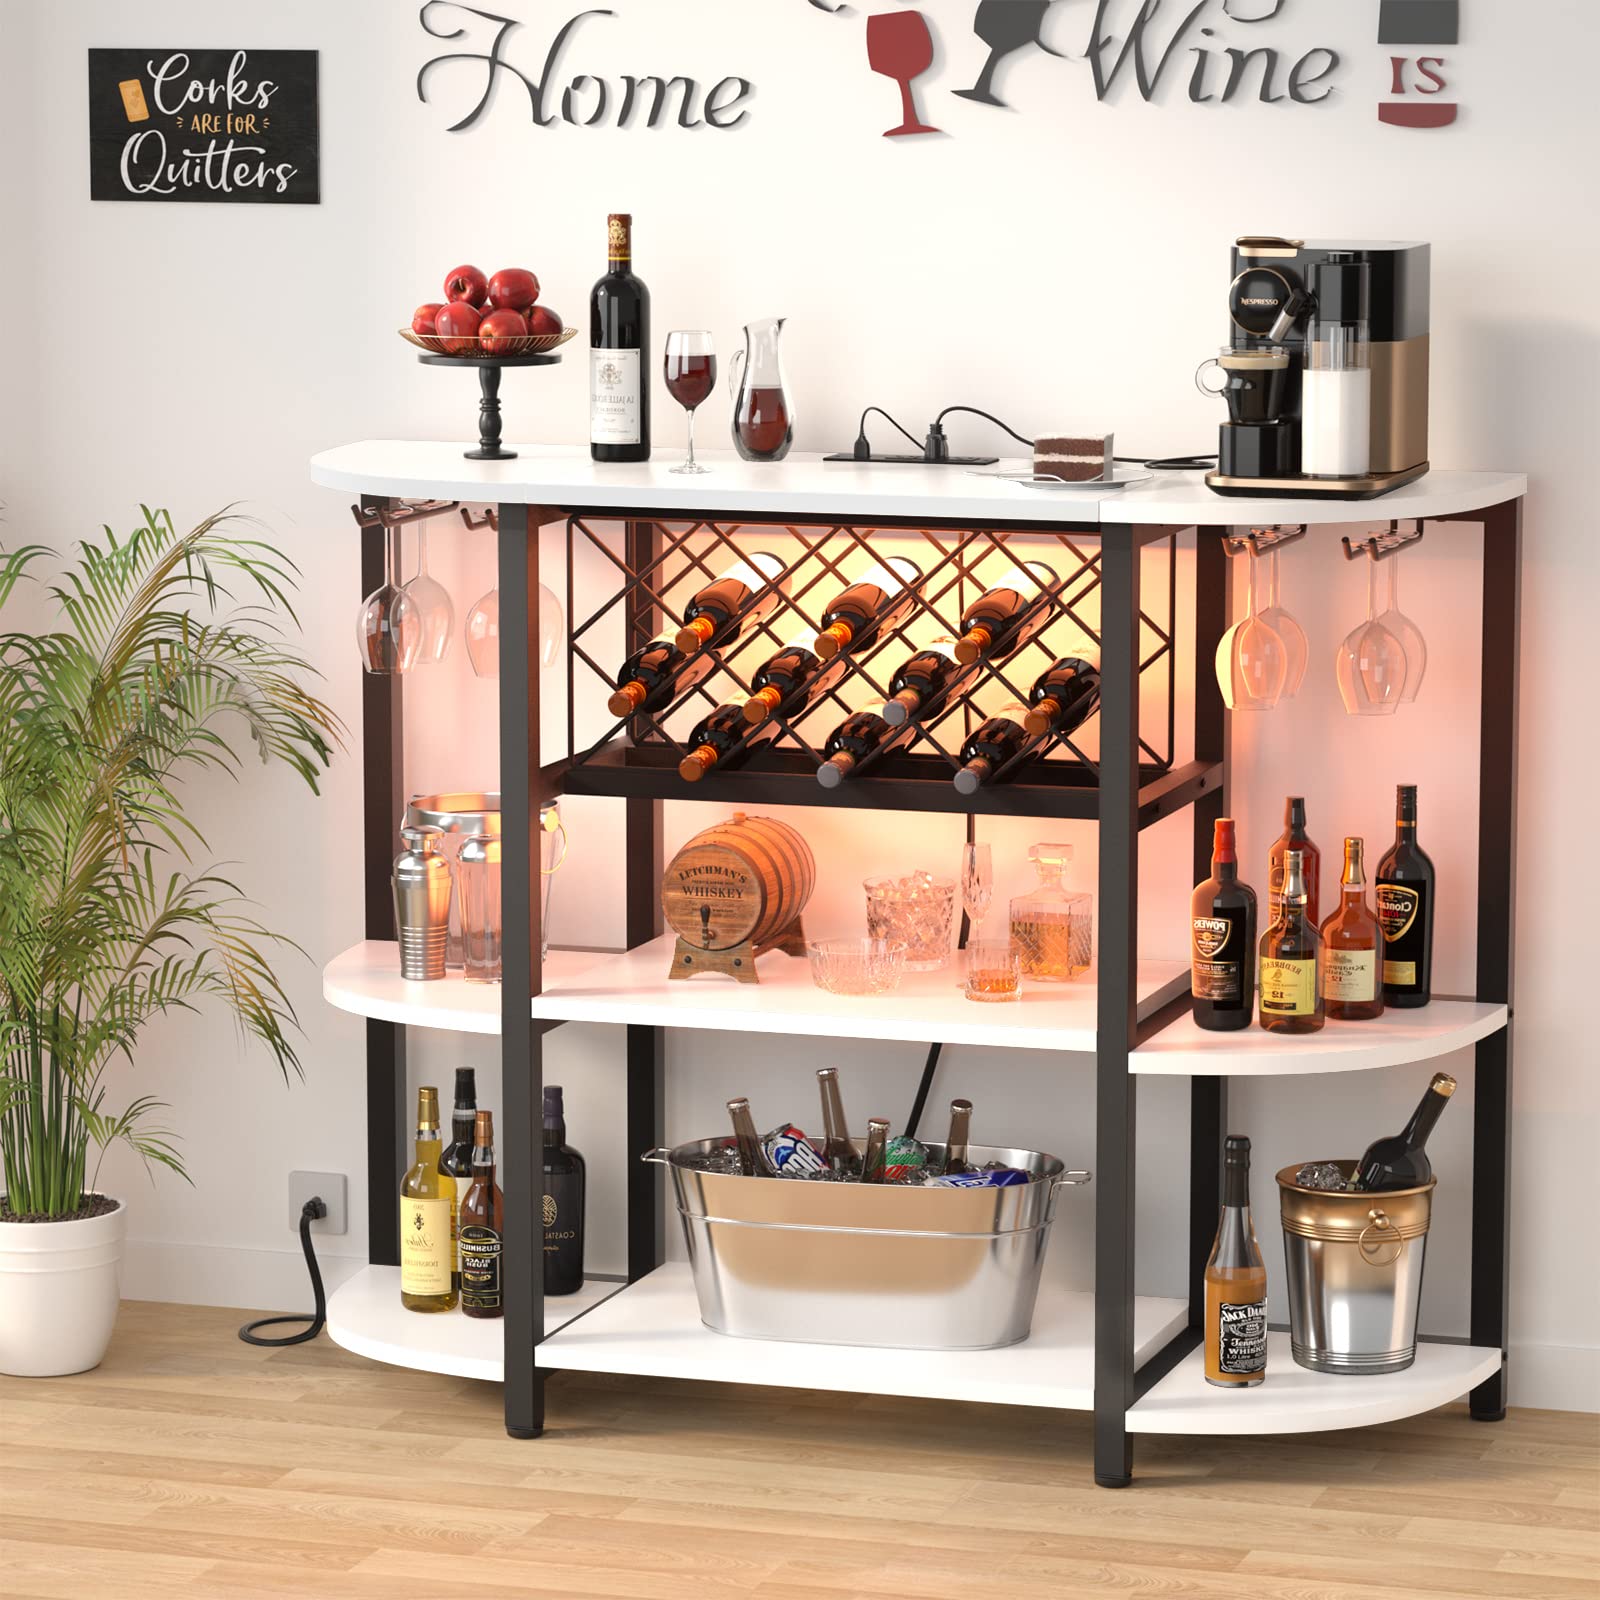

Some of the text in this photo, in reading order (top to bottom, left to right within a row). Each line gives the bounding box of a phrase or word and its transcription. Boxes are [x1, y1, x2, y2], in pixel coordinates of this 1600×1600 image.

[417, 0, 751, 131] Home
[1085, 0, 1336, 103] Wine
[147, 50, 279, 115] Corks
[1390, 56, 1446, 94] IS
[191, 113, 260, 134] ARE FOR
[120, 129, 298, 193] Quitters
[1240, 297, 1279, 306] NESPRESSO
[679, 866, 747, 883] LETCHMAN'S
[682, 886, 744, 899] WHISKEY
[1221, 1309, 1247, 1322] JACK
